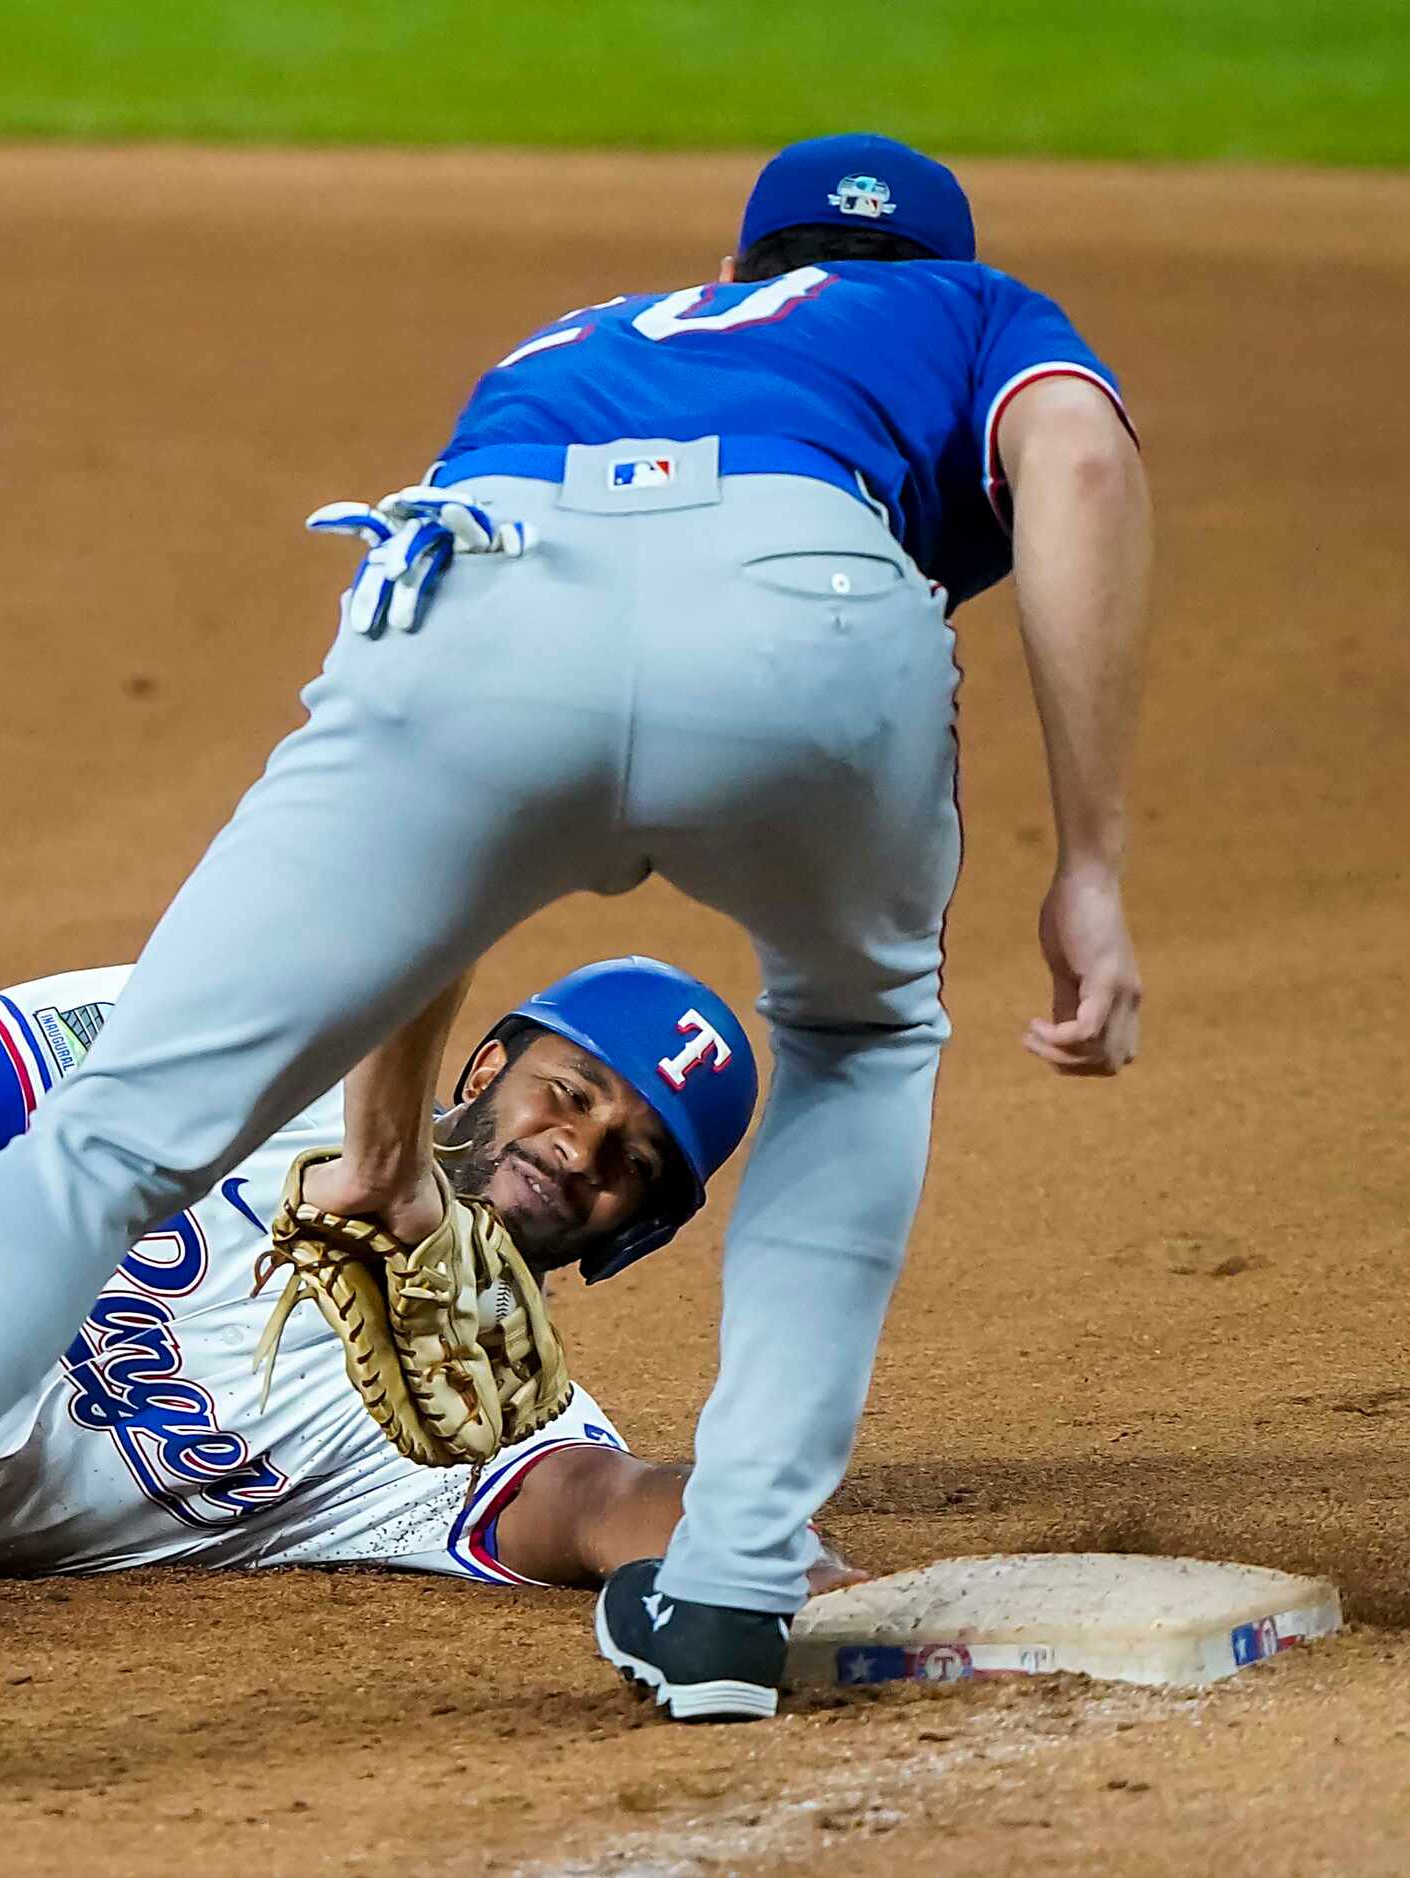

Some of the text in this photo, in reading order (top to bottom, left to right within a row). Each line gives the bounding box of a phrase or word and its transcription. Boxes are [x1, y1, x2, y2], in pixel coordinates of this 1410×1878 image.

[40, 1013, 75, 1071] INAUGURAL
[657, 1008, 732, 1092] T
[60, 1207, 289, 1531] anger
